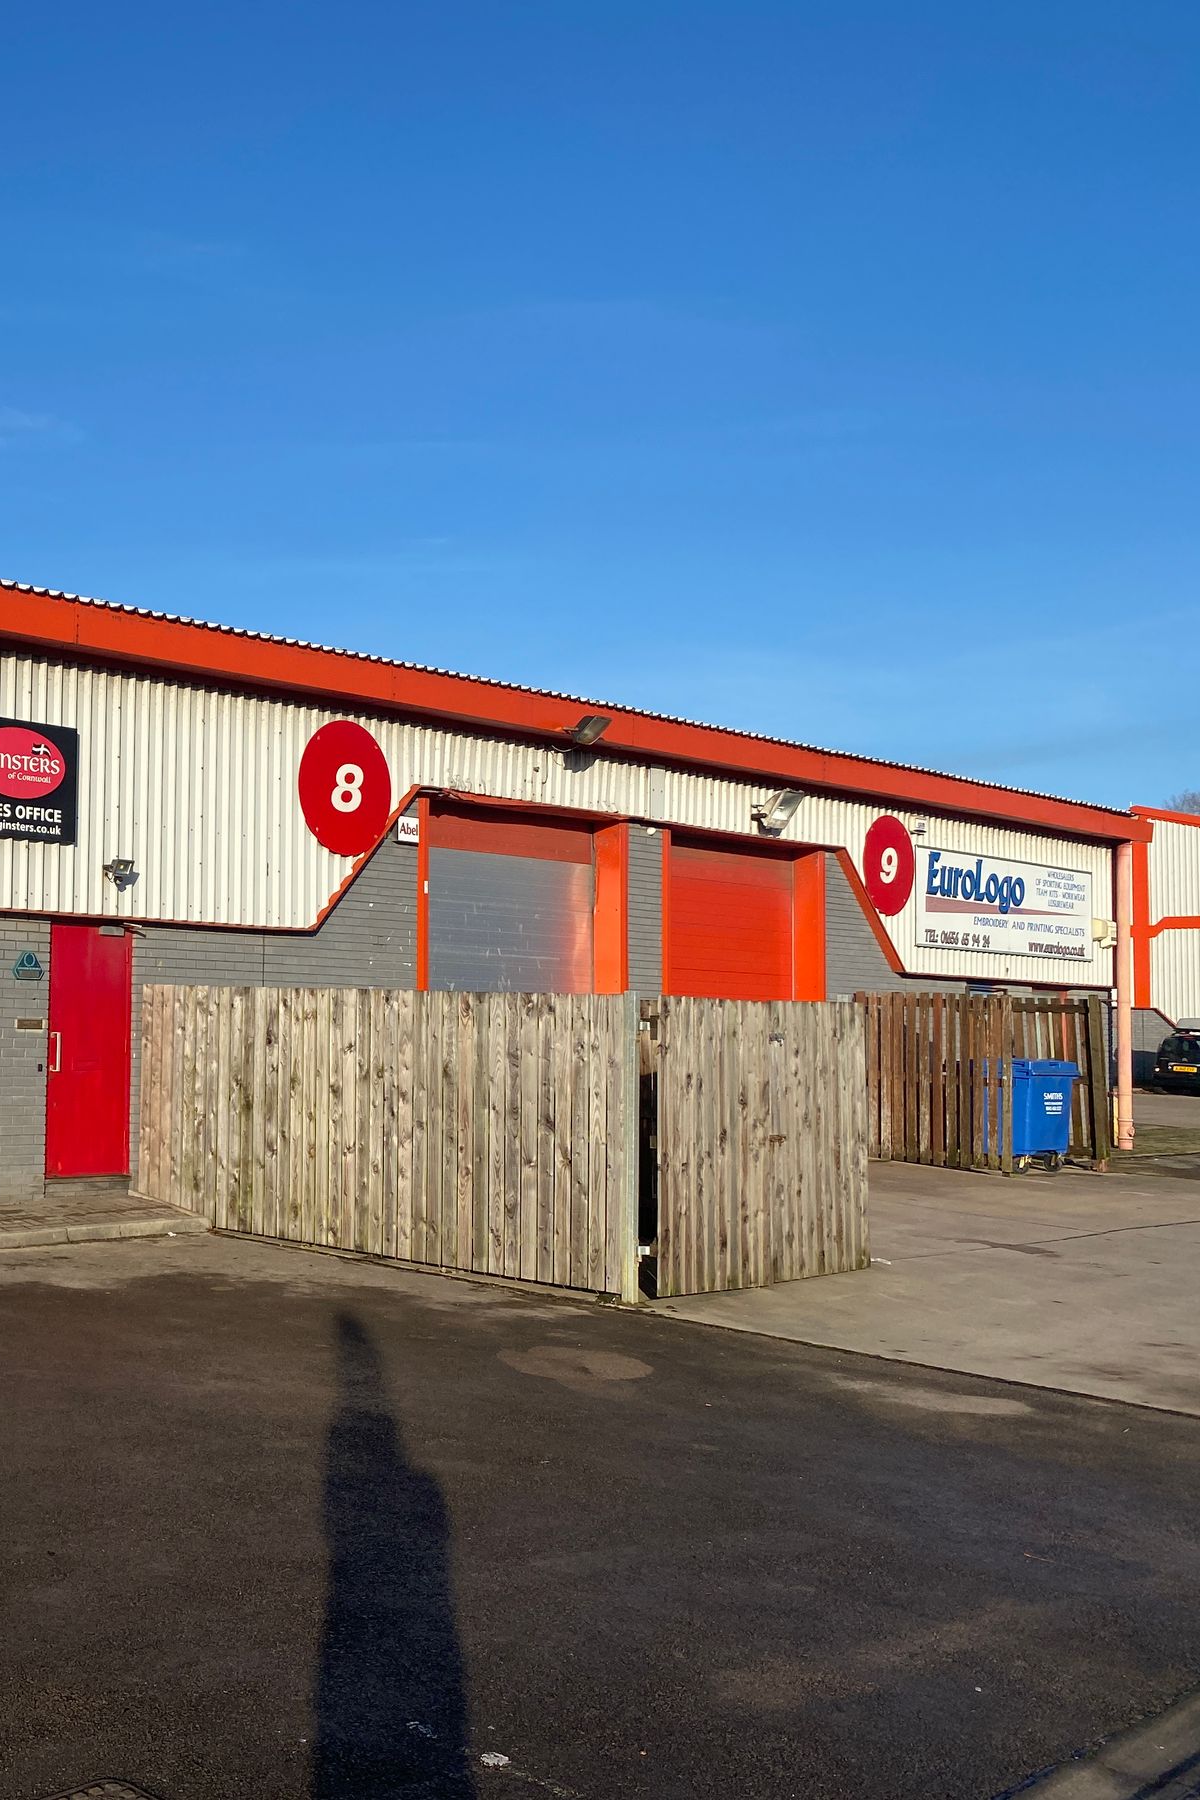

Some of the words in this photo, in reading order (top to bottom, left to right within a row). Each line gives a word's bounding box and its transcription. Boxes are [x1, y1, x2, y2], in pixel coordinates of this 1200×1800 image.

[7, 772, 16, 780] of
[17, 772, 51, 784] Cornwall
[331, 763, 364, 813] 8
[15, 805, 62, 823] OFFICE
[399, 822, 418, 836] Abel
[879, 847, 898, 884] 9
[973, 916, 1009, 928] EMBROIDERY
[1012, 921, 1025, 930] AND
[1026, 922, 1054, 933] PRINTING
[1054, 925, 1085, 936] SPECIALISTS
[924, 929, 938, 943] TEL:
